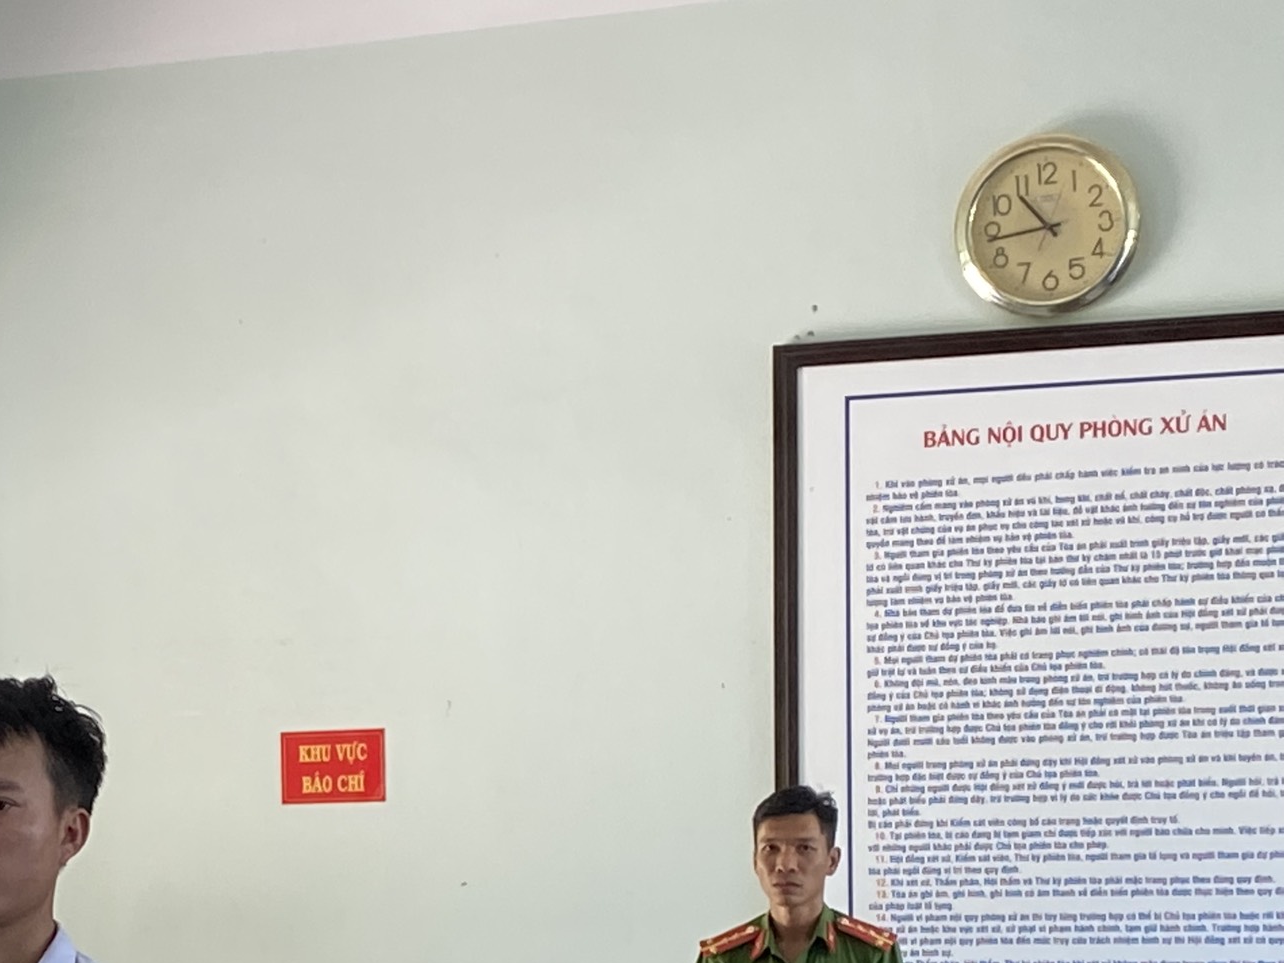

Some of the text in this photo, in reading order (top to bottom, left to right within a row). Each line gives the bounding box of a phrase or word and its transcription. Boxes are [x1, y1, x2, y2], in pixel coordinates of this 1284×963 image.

[1037, 162, 1057, 185] 12
[1072, 170, 1076, 192] 1
[1015, 174, 1028, 196] 11
[1088, 184, 1103, 207] 2
[993, 194, 1011, 216] 10
[984, 222, 1001, 241] 9
[1098, 210, 1114, 231] 3
[993, 247, 1008, 268] 8
[1091, 238, 1104, 258] 4
[1017, 262, 1031, 284] 7
[1069, 257, 1085, 280] 5
[1042, 270, 1059, 291] 6
[923, 407, 1227, 449] BẢNG NỘI QUY PHÒNG XỬ ÁN
[299, 741, 368, 764] KHU VỰC
[302, 770, 365, 794] BÁO CHÍ
